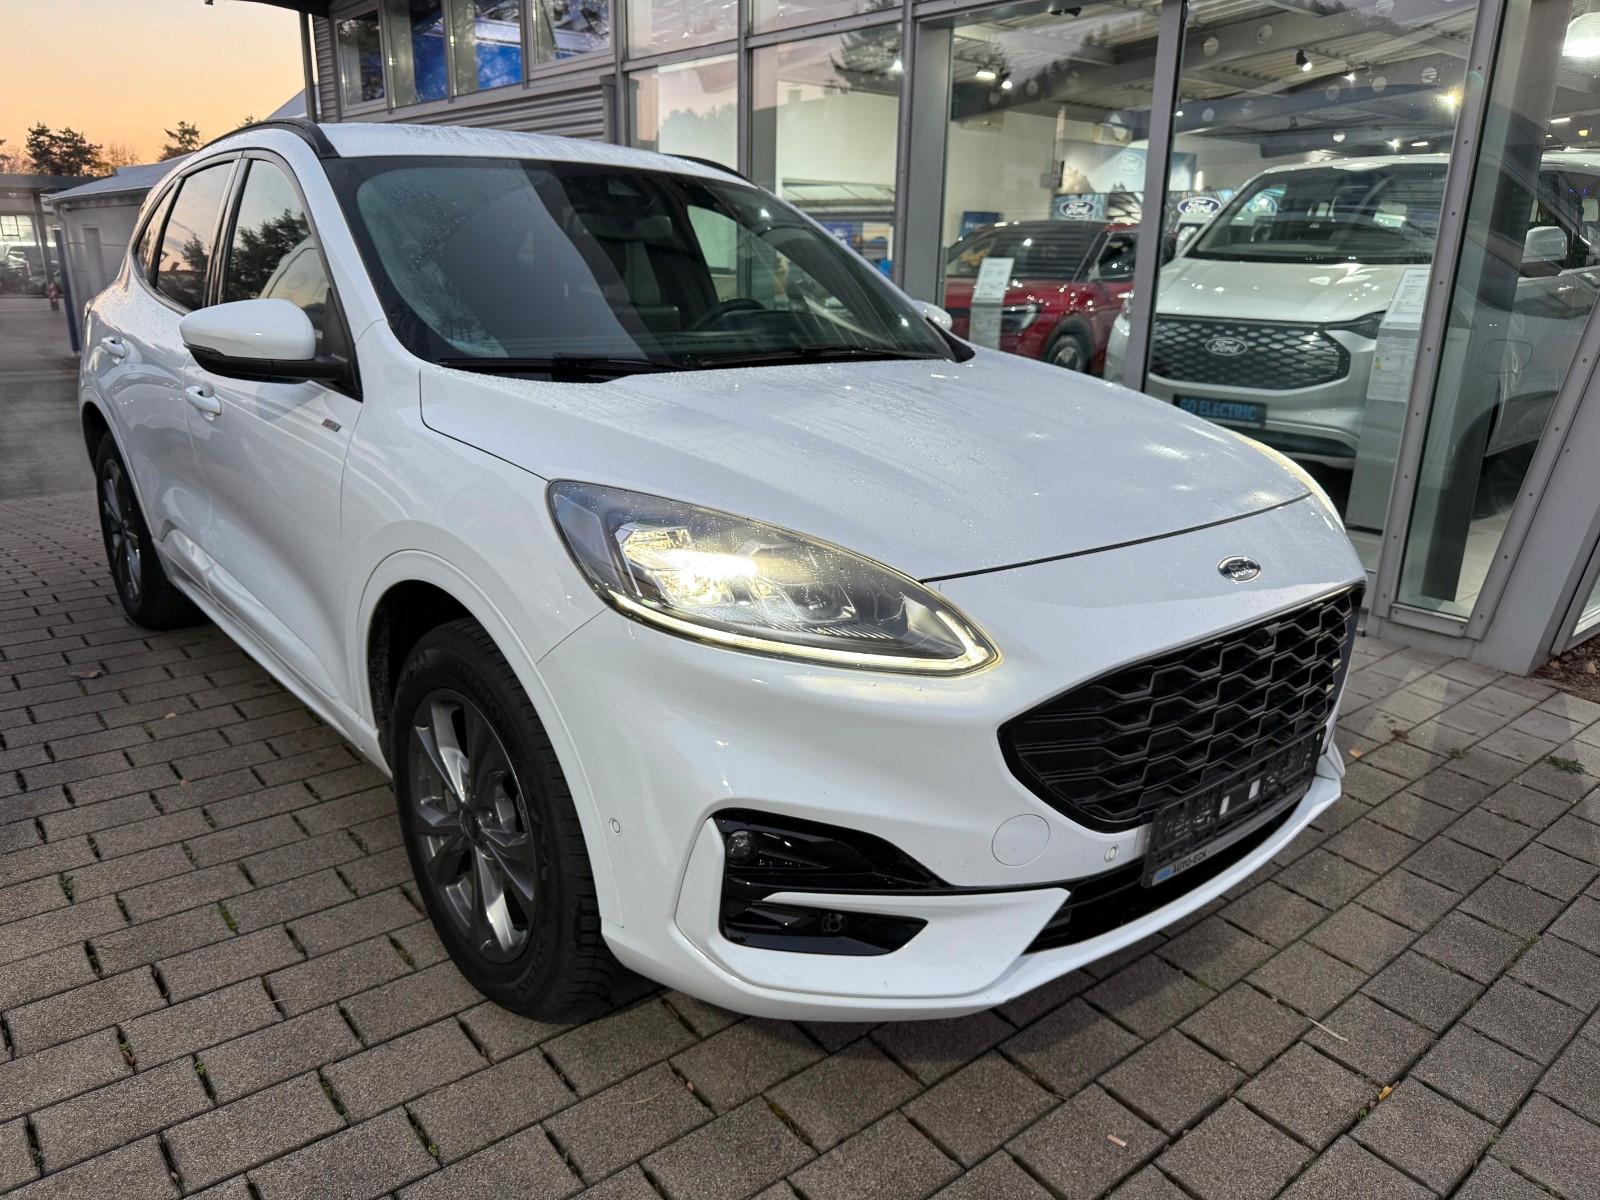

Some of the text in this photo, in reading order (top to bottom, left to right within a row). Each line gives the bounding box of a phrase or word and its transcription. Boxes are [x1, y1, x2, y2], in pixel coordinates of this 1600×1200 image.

[1065, 201, 1091, 215] Ford
[1183, 199, 1215, 215] Ford
[1210, 339, 1242, 354] Ford
[1180, 398, 1257, 421] GO ELECTRIC
[1173, 850, 1208, 873] AUTO-ECK
